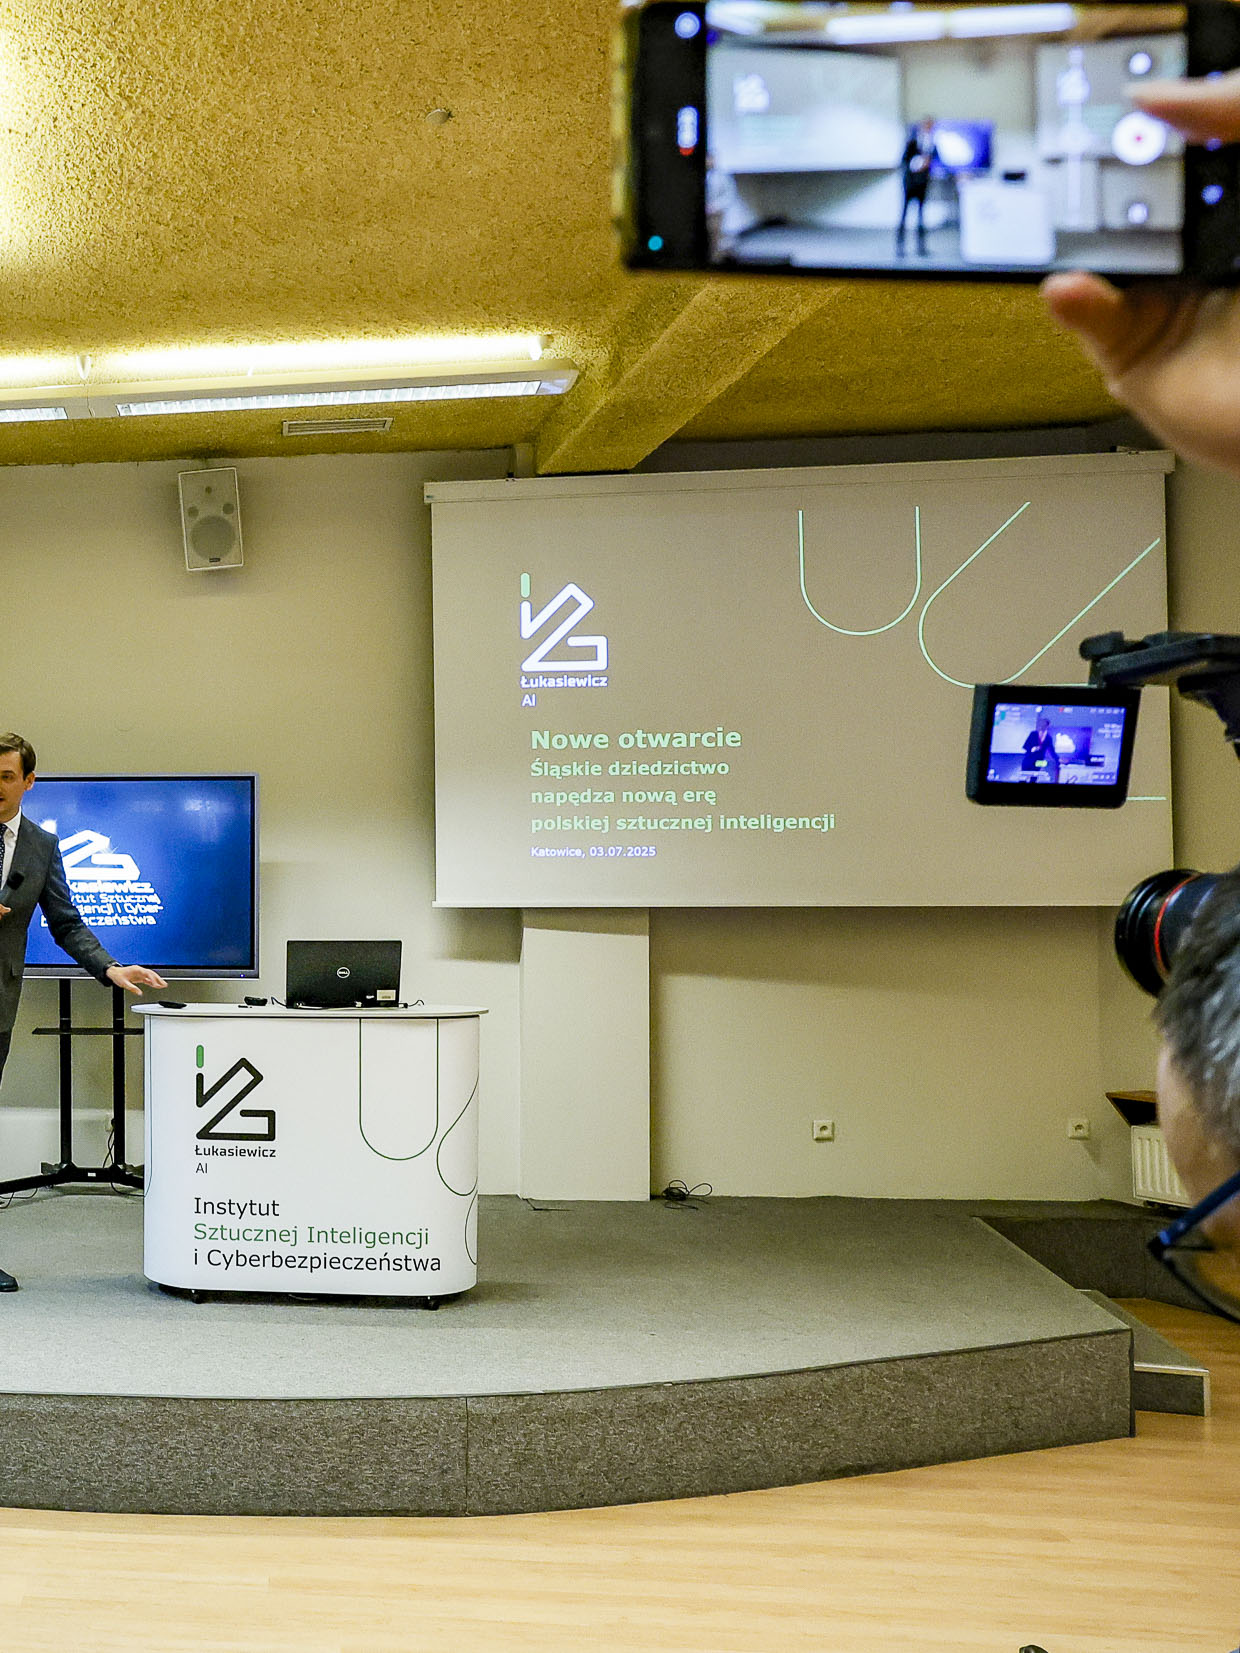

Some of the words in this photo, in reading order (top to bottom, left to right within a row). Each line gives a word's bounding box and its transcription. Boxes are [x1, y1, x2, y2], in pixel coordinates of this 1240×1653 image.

[520, 675, 608, 688] Łukasiewicz
[521, 694, 536, 706] AI
[531, 730, 609, 749] Nowe
[618, 727, 742, 748] otwarcie
[531, 758, 602, 779] Śląskie
[608, 760, 730, 776] dziedzictwo
[531, 788, 615, 806] napędza
[622, 791, 677, 805] nową
[683, 790, 717, 805] erę
[531, 815, 610, 833] polskiej
[616, 815, 712, 832] sztucznej
[719, 814, 835, 832] inteligencji
[531, 846, 585, 858] Katowice,
[589, 846, 656, 857] 03.07.2025
[67, 880, 154, 893] kasiewicz
[195, 1145, 276, 1158] Łukasiewicz
[196, 1163, 208, 1173] AI
[194, 1197, 279, 1219] Instytut
[194, 1223, 297, 1246] Sztucznej
[307, 1226, 429, 1249] Inteligencji
[194, 1249, 198, 1265] i
[207, 1249, 441, 1273] Cyberbezpieczeństwa
